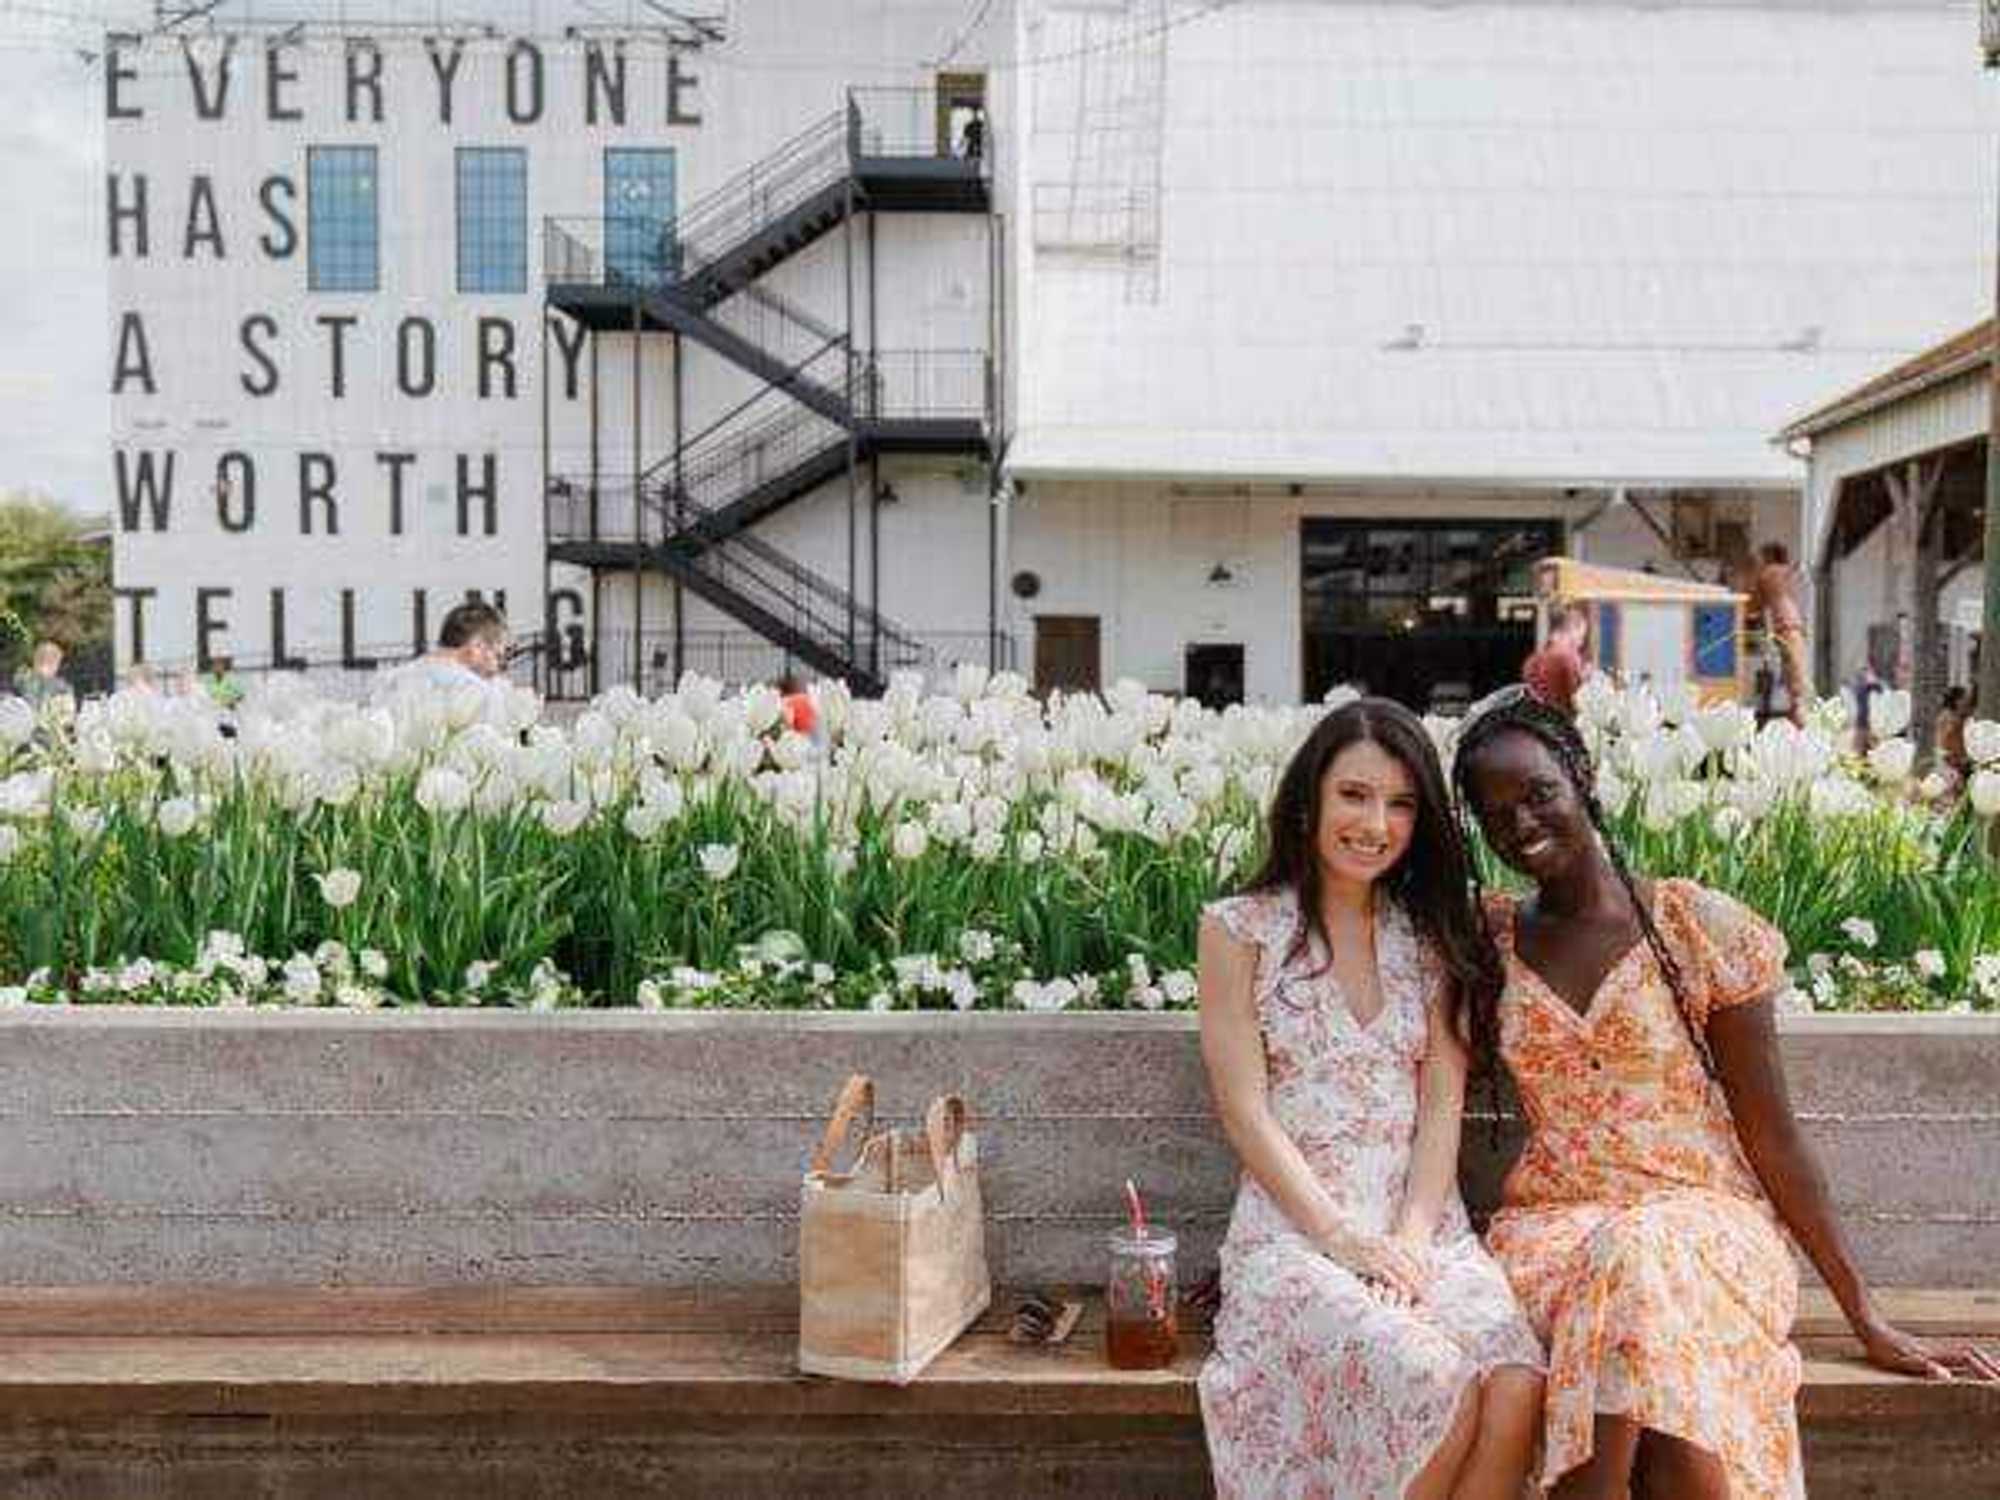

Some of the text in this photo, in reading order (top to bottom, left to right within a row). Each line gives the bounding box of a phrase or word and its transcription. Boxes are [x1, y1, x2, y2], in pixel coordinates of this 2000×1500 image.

[106, 35, 702, 125] EVERYONE
[107, 174, 298, 259] HAS
[112, 312, 587, 399] A STORY
[115, 450, 497, 534] WORTH
[113, 587, 584, 670] TELLIG
